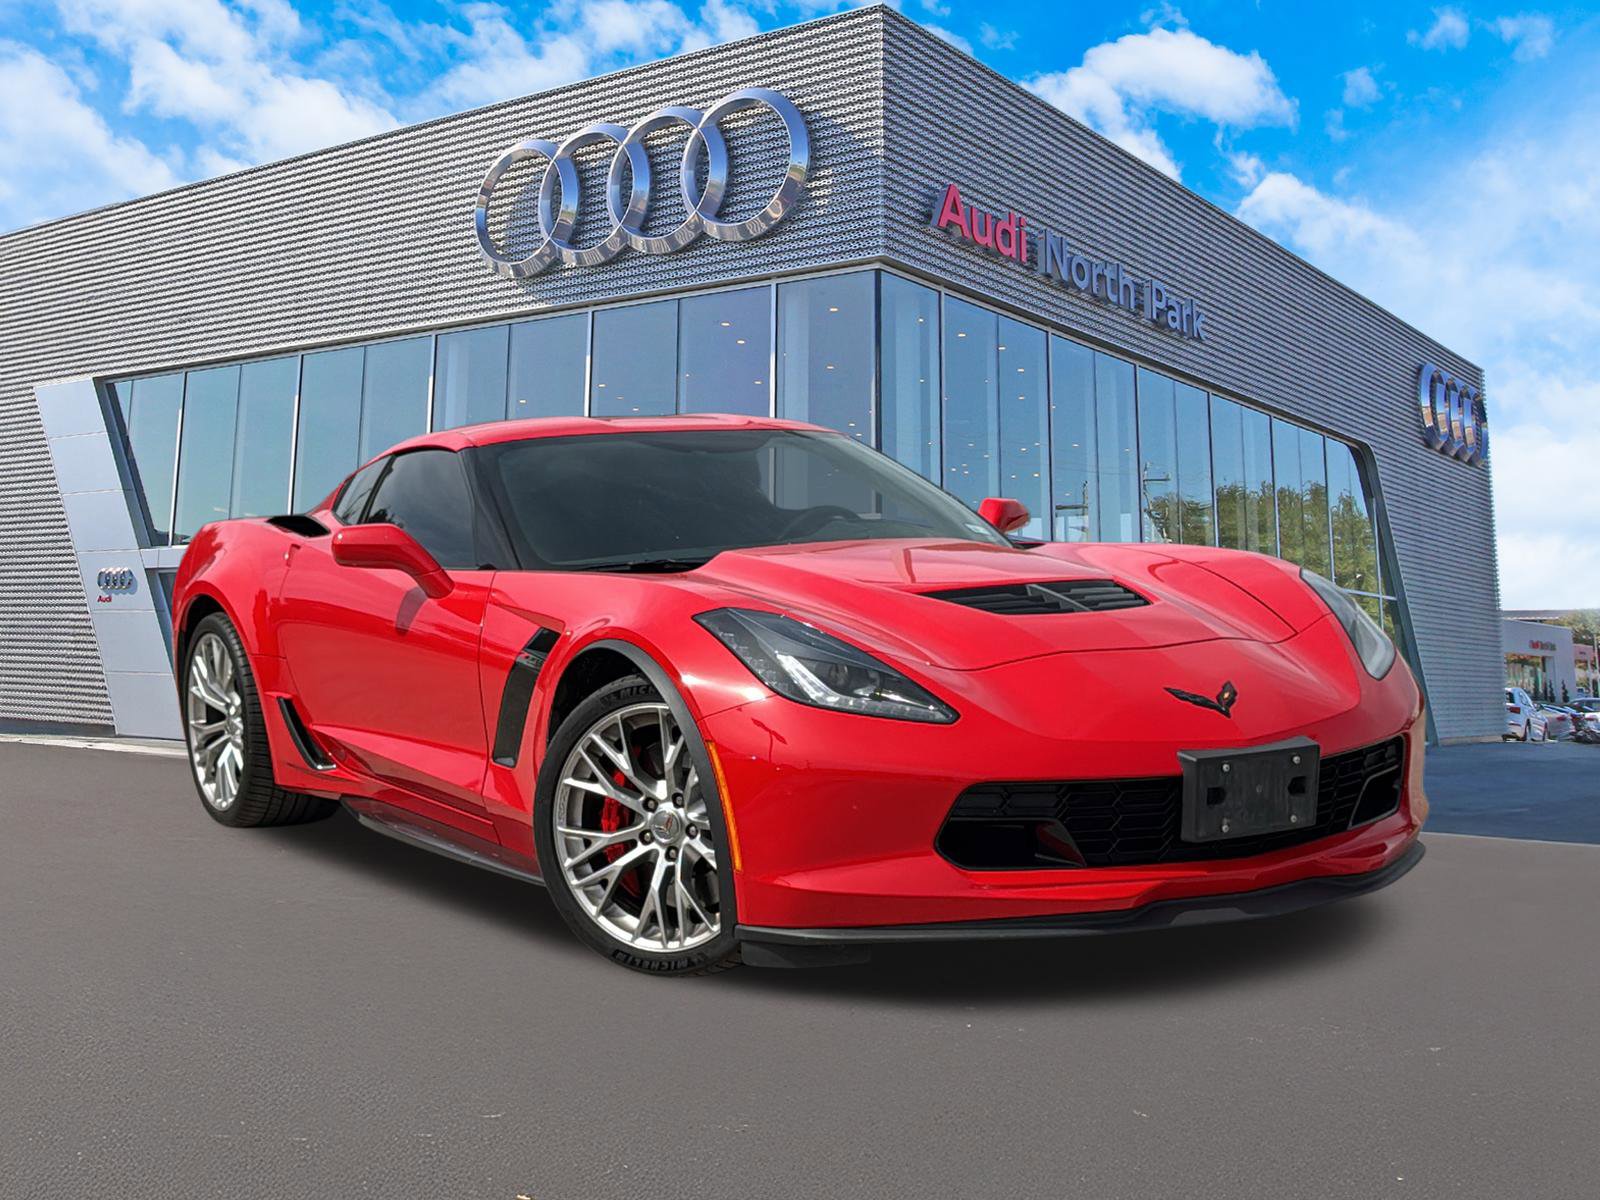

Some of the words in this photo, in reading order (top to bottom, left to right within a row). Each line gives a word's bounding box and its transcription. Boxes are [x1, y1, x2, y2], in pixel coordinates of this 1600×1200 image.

[934, 183, 1027, 264] Audi
[1038, 229, 1137, 309] North
[1144, 279, 1206, 341] Park
[97, 595, 113, 603] Audi
[613, 951, 689, 971] MICHELIN
